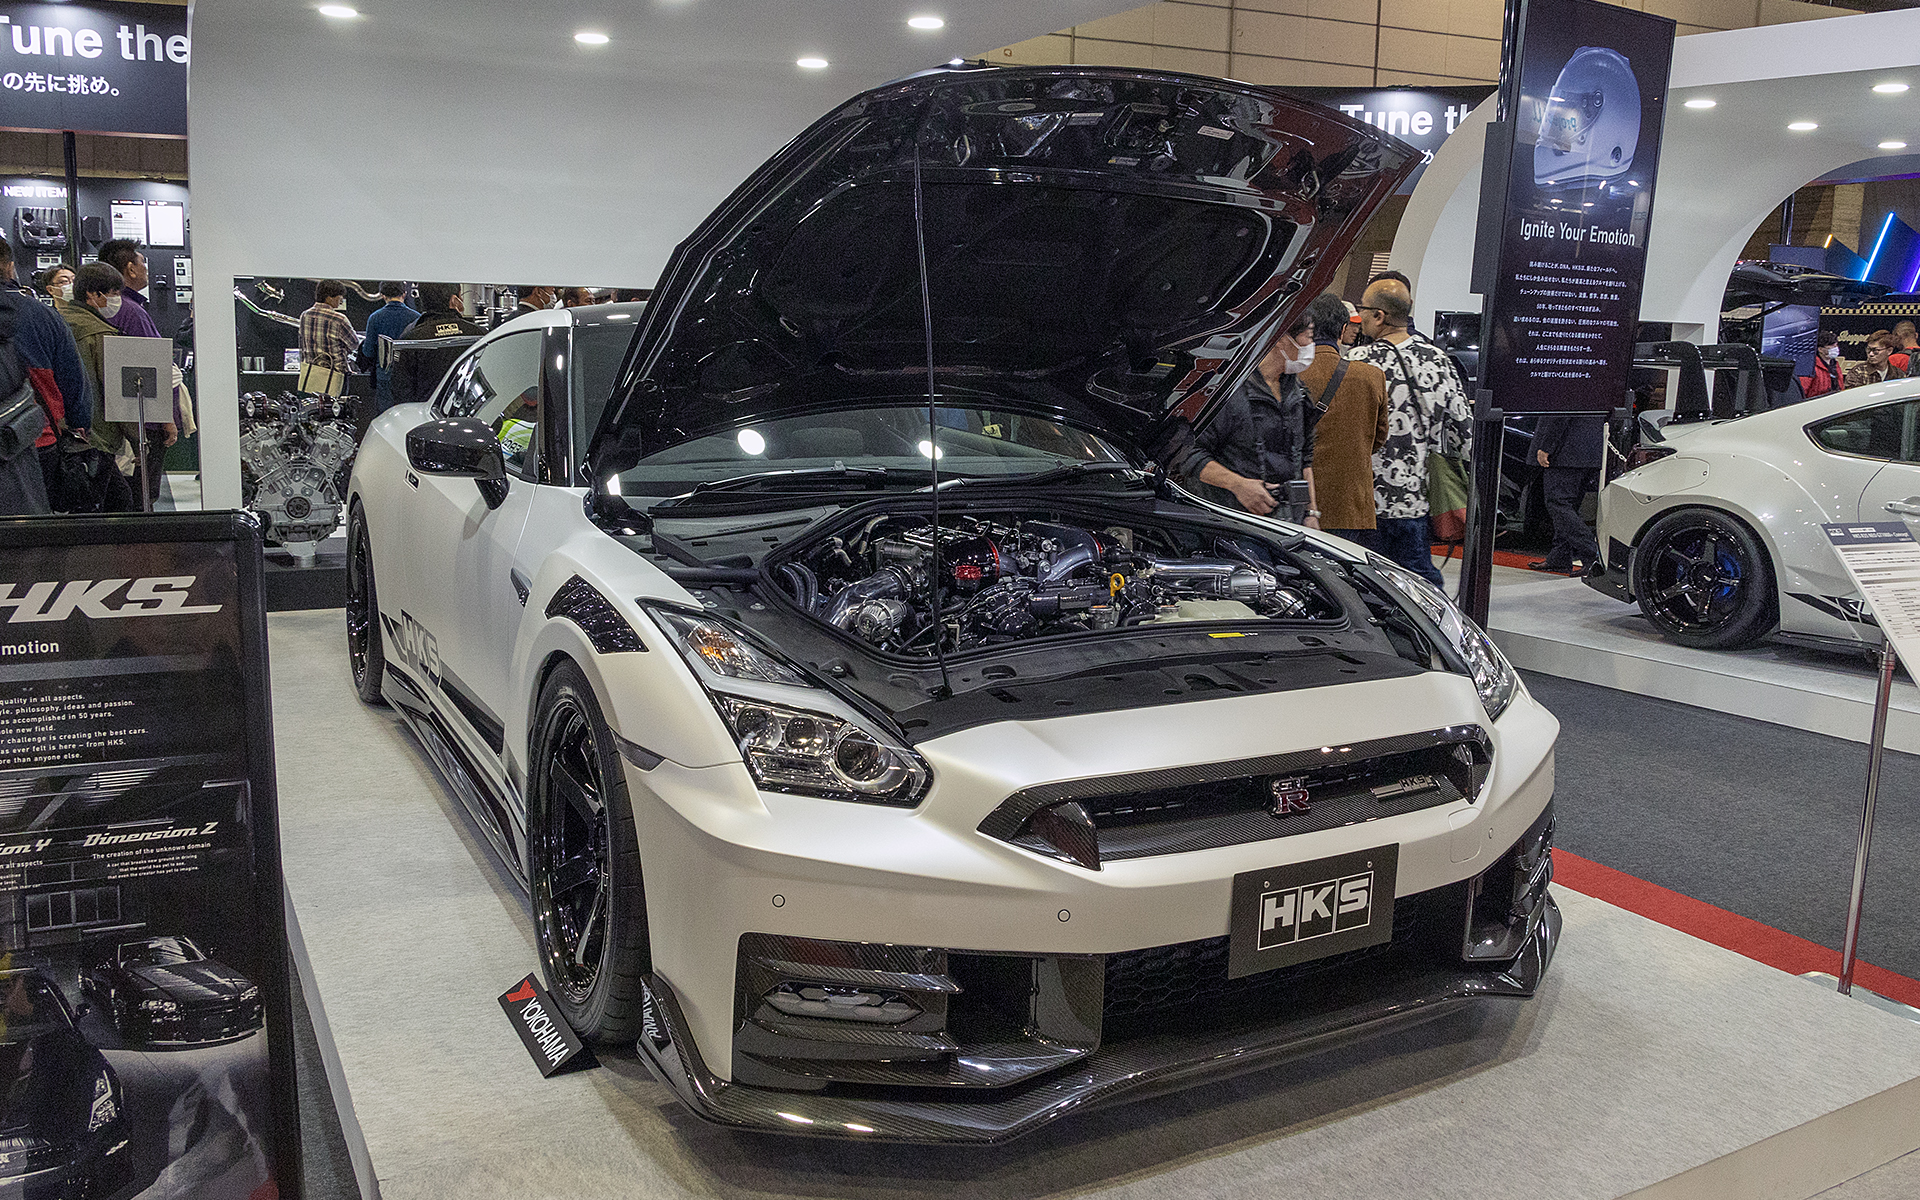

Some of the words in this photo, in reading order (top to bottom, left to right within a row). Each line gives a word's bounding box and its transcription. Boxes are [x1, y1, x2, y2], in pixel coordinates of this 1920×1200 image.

[0, 15, 103, 58] une
[116, 24, 188, 64] the
[0, 72, 120, 97] の先に挑め。
[3, 185, 35, 198] NEW
[35, 186, 68, 198] ITEM
[1520, 218, 1555, 241] Ignite
[1560, 222, 1586, 241] Your
[1589, 225, 1636, 246] Emotion
[0, 575, 223, 623] HKS
[1, 640, 59, 655] motion
[402, 615, 440, 678] HKS
[53, 694, 85, 703] aspects.
[64, 703, 85, 711] ideas
[88, 701, 102, 709] and
[104, 700, 135, 708] passion.
[12, 713, 66, 725] accomplished
[90, 711, 114, 719] years.
[7, 735, 47, 744] challenge
[59, 731, 92, 741] creating
[94, 730, 107, 738] the
[109, 729, 127, 737] best
[128, 727, 149, 736] cars.
[86, 740, 105, 748] from
[14, 756, 31, 764] than
[34, 753, 61, 763] anyone
[63, 752, 83, 760] else.
[1400, 775, 1426, 787] HKS
[83, 826, 198, 847] Dimension
[200, 821, 219, 835] Z
[106, 850, 134, 859] creation
[156, 845, 185, 853] unknown
[187, 841, 211, 850] domain
[17, 860, 43, 868] aspects
[1262, 877, 1370, 931] HKS
[519, 996, 570, 1067] YOKOHAMA
